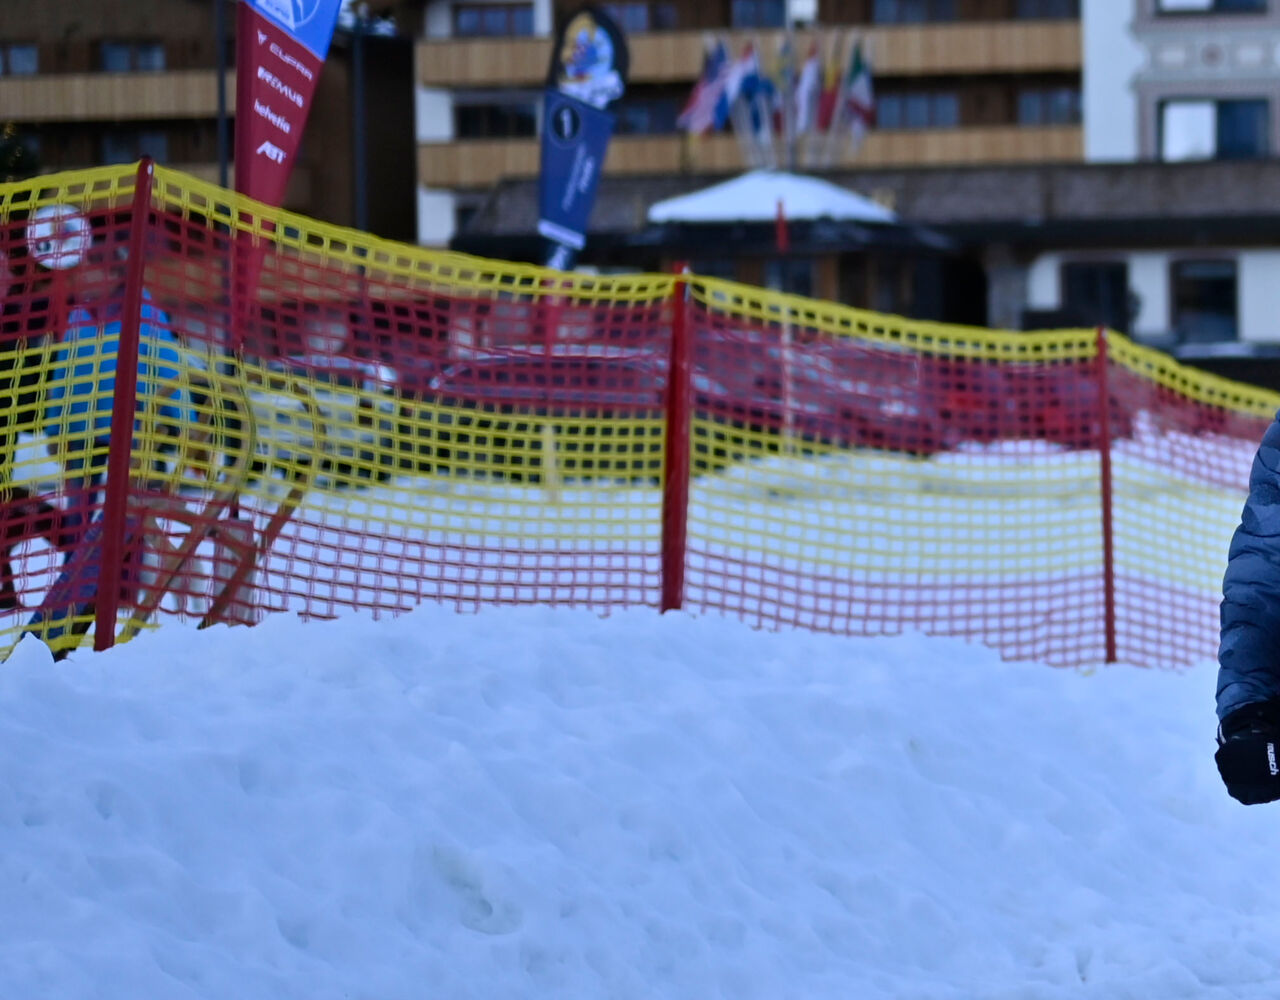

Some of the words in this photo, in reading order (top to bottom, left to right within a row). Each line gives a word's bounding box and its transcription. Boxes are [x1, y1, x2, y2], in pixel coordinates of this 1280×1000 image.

[254, 98, 290, 133] helvetia
[256, 140, 287, 164] ABT
[1267, 742, 1280, 776] reusch
